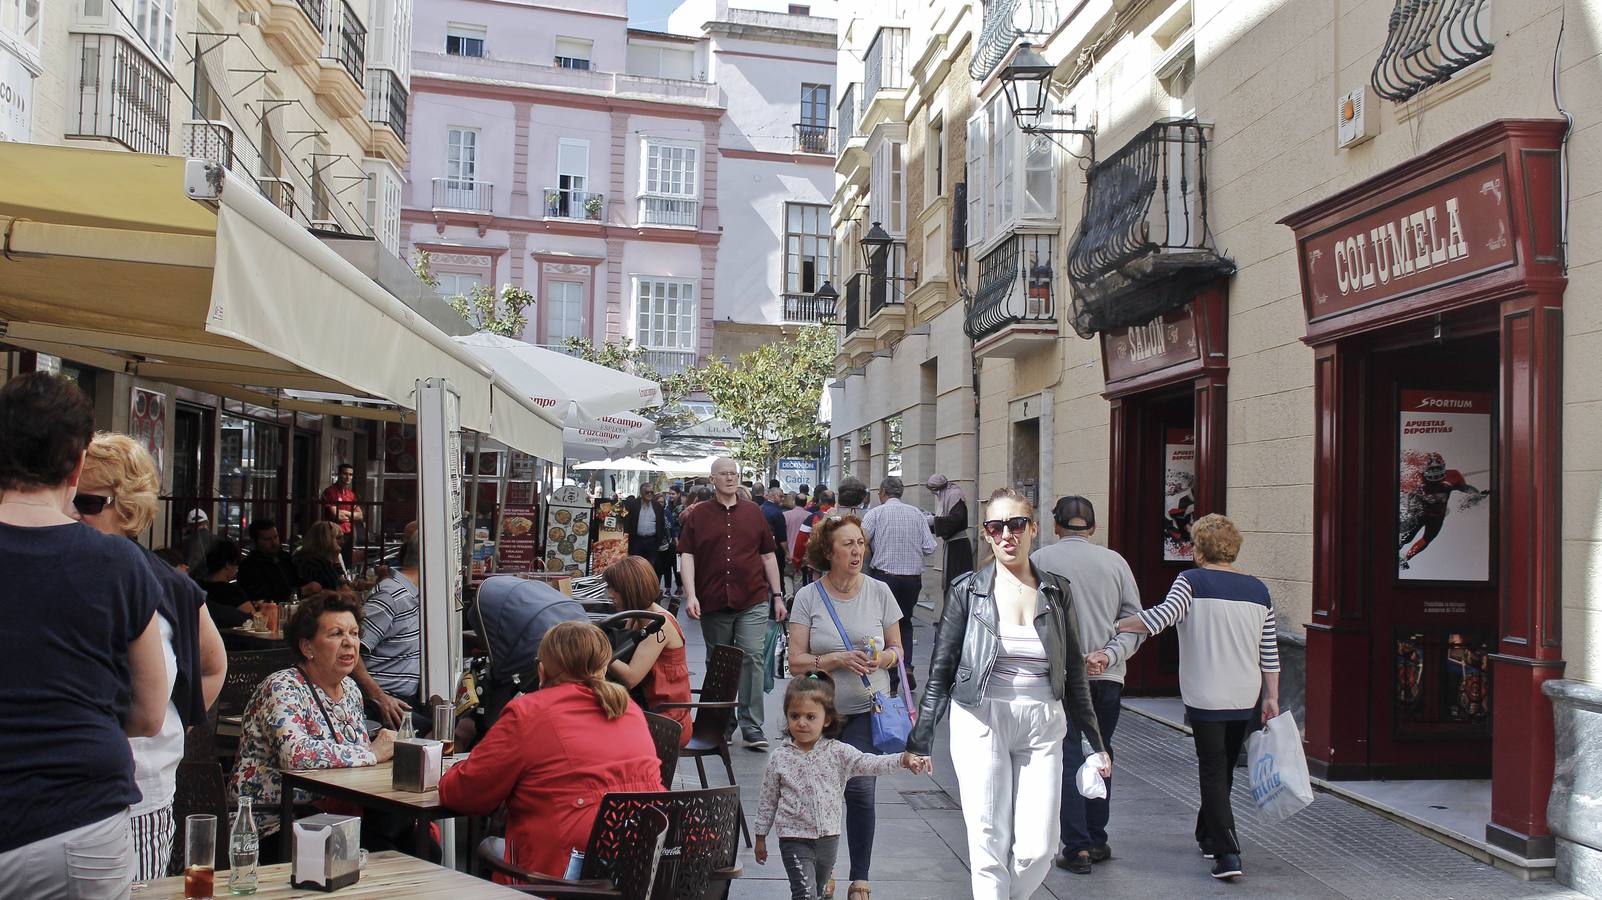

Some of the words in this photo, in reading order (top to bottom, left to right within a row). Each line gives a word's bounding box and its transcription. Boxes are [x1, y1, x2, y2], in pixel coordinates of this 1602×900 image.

[1335, 197, 1469, 296] COLUMELA
[1416, 397, 1473, 409] SPORTIUM
[597, 416, 643, 429] uzcampo
